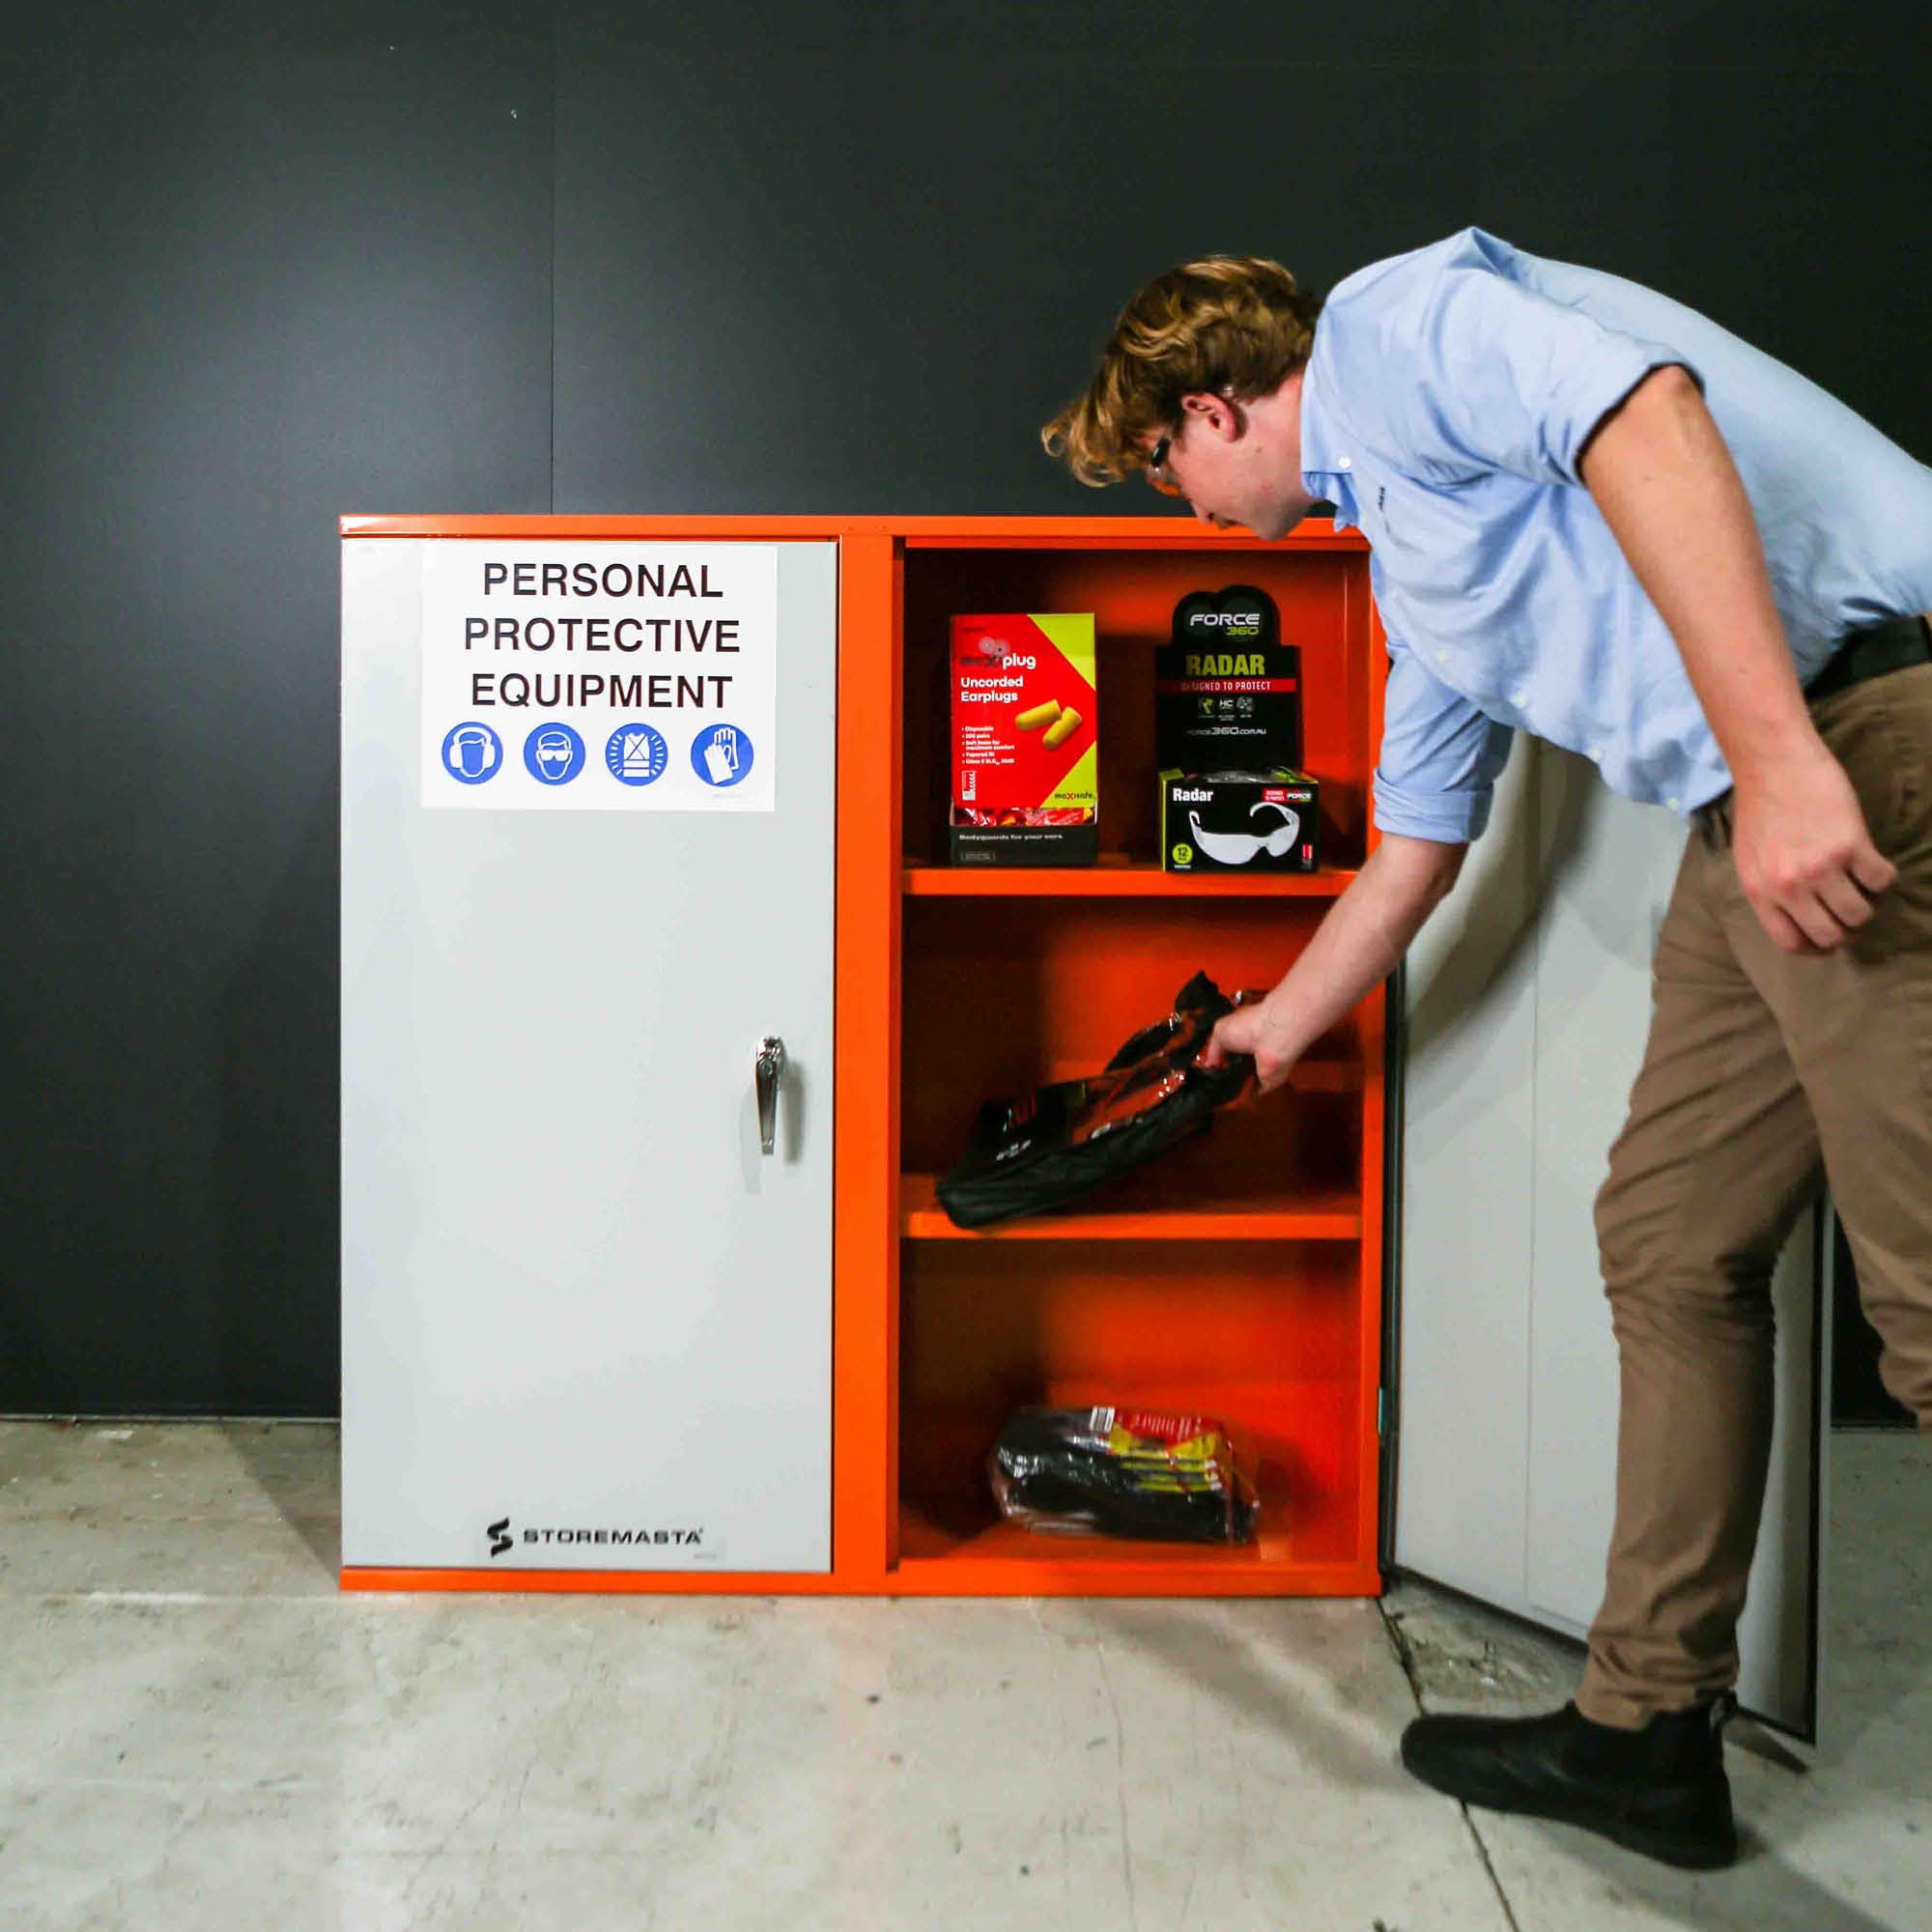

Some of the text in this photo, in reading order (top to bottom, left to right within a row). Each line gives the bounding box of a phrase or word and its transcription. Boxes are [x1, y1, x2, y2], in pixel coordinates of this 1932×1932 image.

[483, 562, 724, 598] PERSONAL
[1189, 612, 1261, 626] FORCE
[465, 617, 741, 653] PROTECTIVE
[1226, 626, 1260, 636] 360
[1185, 654, 1265, 676] RADAR
[960, 675, 1024, 688] Uncorded
[1223, 681, 1234, 691] TO
[1236, 680, 1271, 692] PROTECT
[471, 672, 733, 708] EQUIPMENT
[960, 690, 1019, 704] Earplugs
[1173, 787, 1213, 802] Radar
[1178, 846, 1188, 857] 12
[523, 1528, 704, 1545] STOREMASTA
